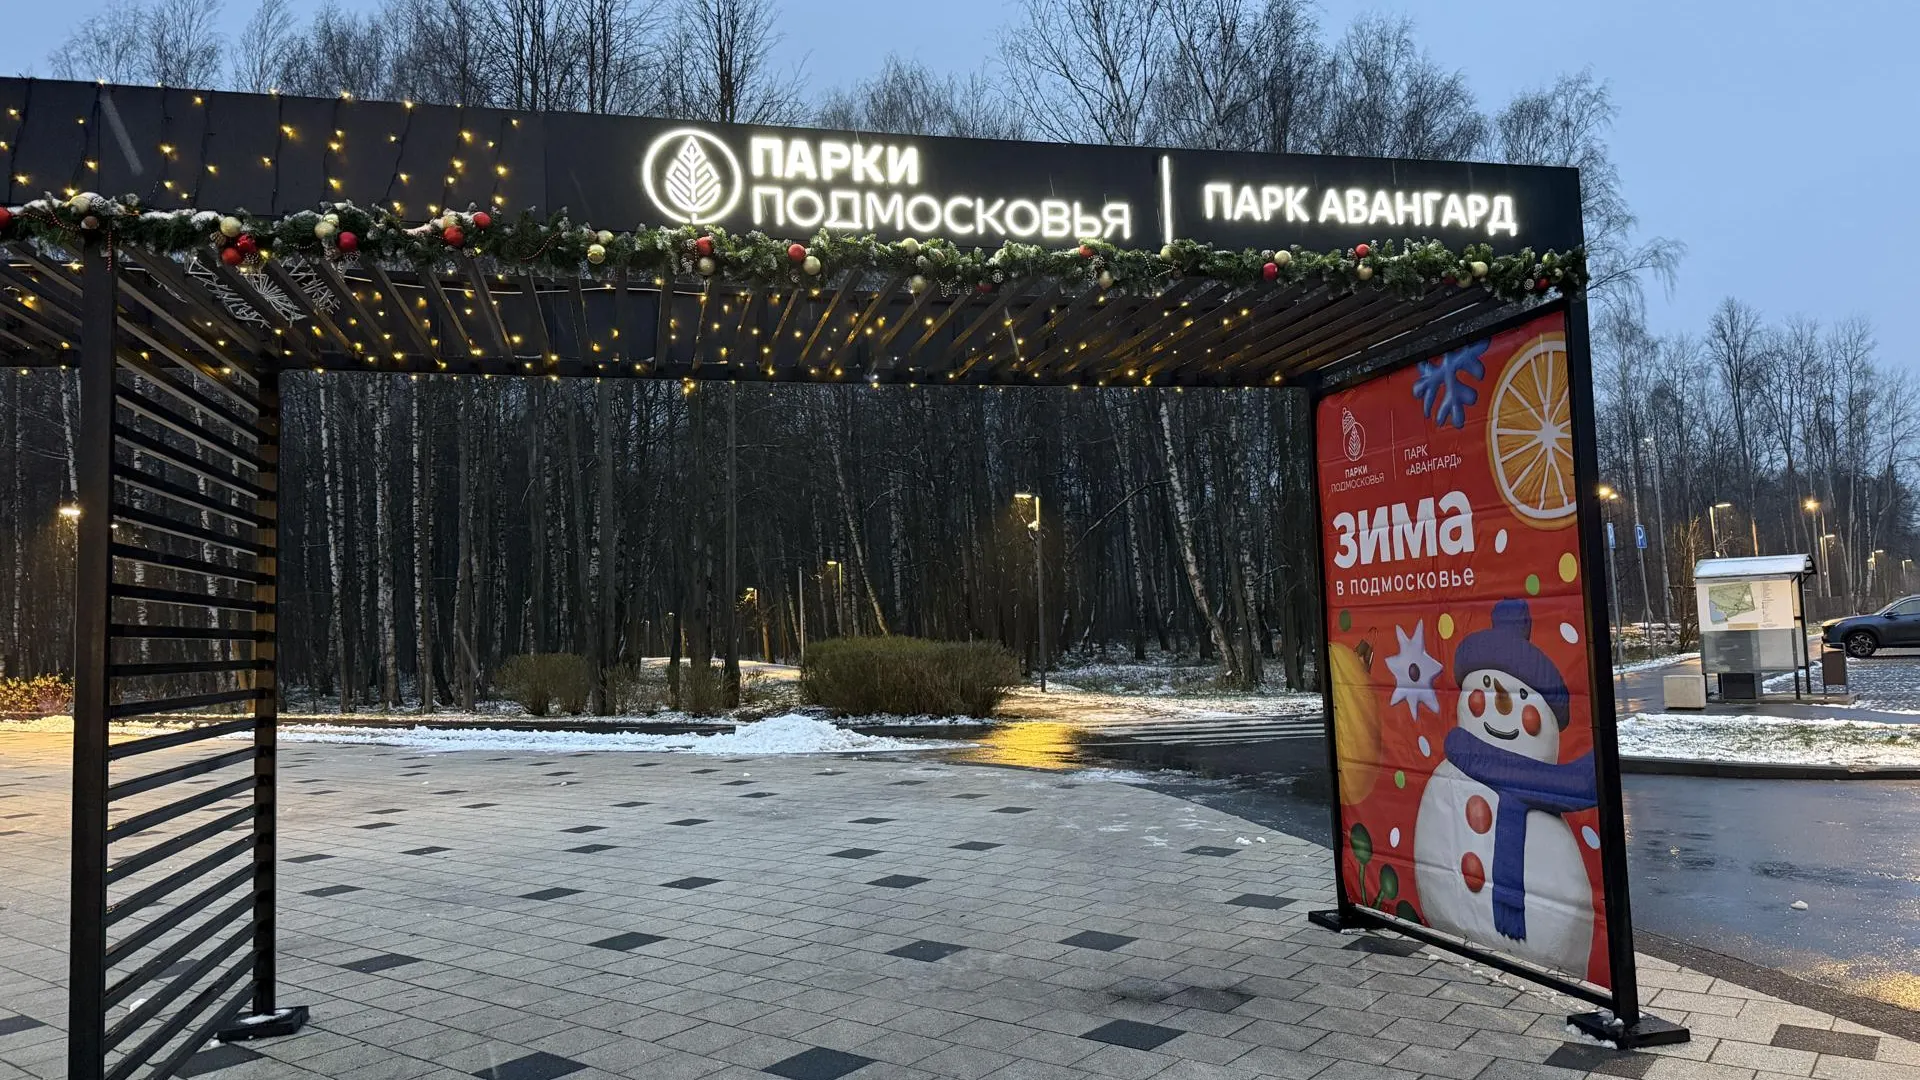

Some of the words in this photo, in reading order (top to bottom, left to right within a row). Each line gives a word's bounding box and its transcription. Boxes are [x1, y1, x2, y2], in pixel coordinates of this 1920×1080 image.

[750, 136, 919, 185] ПАРКИ
[751, 186, 1132, 240] ПОДМОСКОВЬЯ
[1203, 182, 1310, 223] ПАРК
[1317, 187, 1518, 238] АВАНГАРД
[1404, 444, 1428, 461] ПАРК
[1345, 465, 1368, 479] ПАРКИ
[1406, 454, 1462, 476] «АВАНГАРД»
[1330, 472, 1385, 493] ПОДМОСКОВЬЯ
[1636, 526, 1644, 546] P
